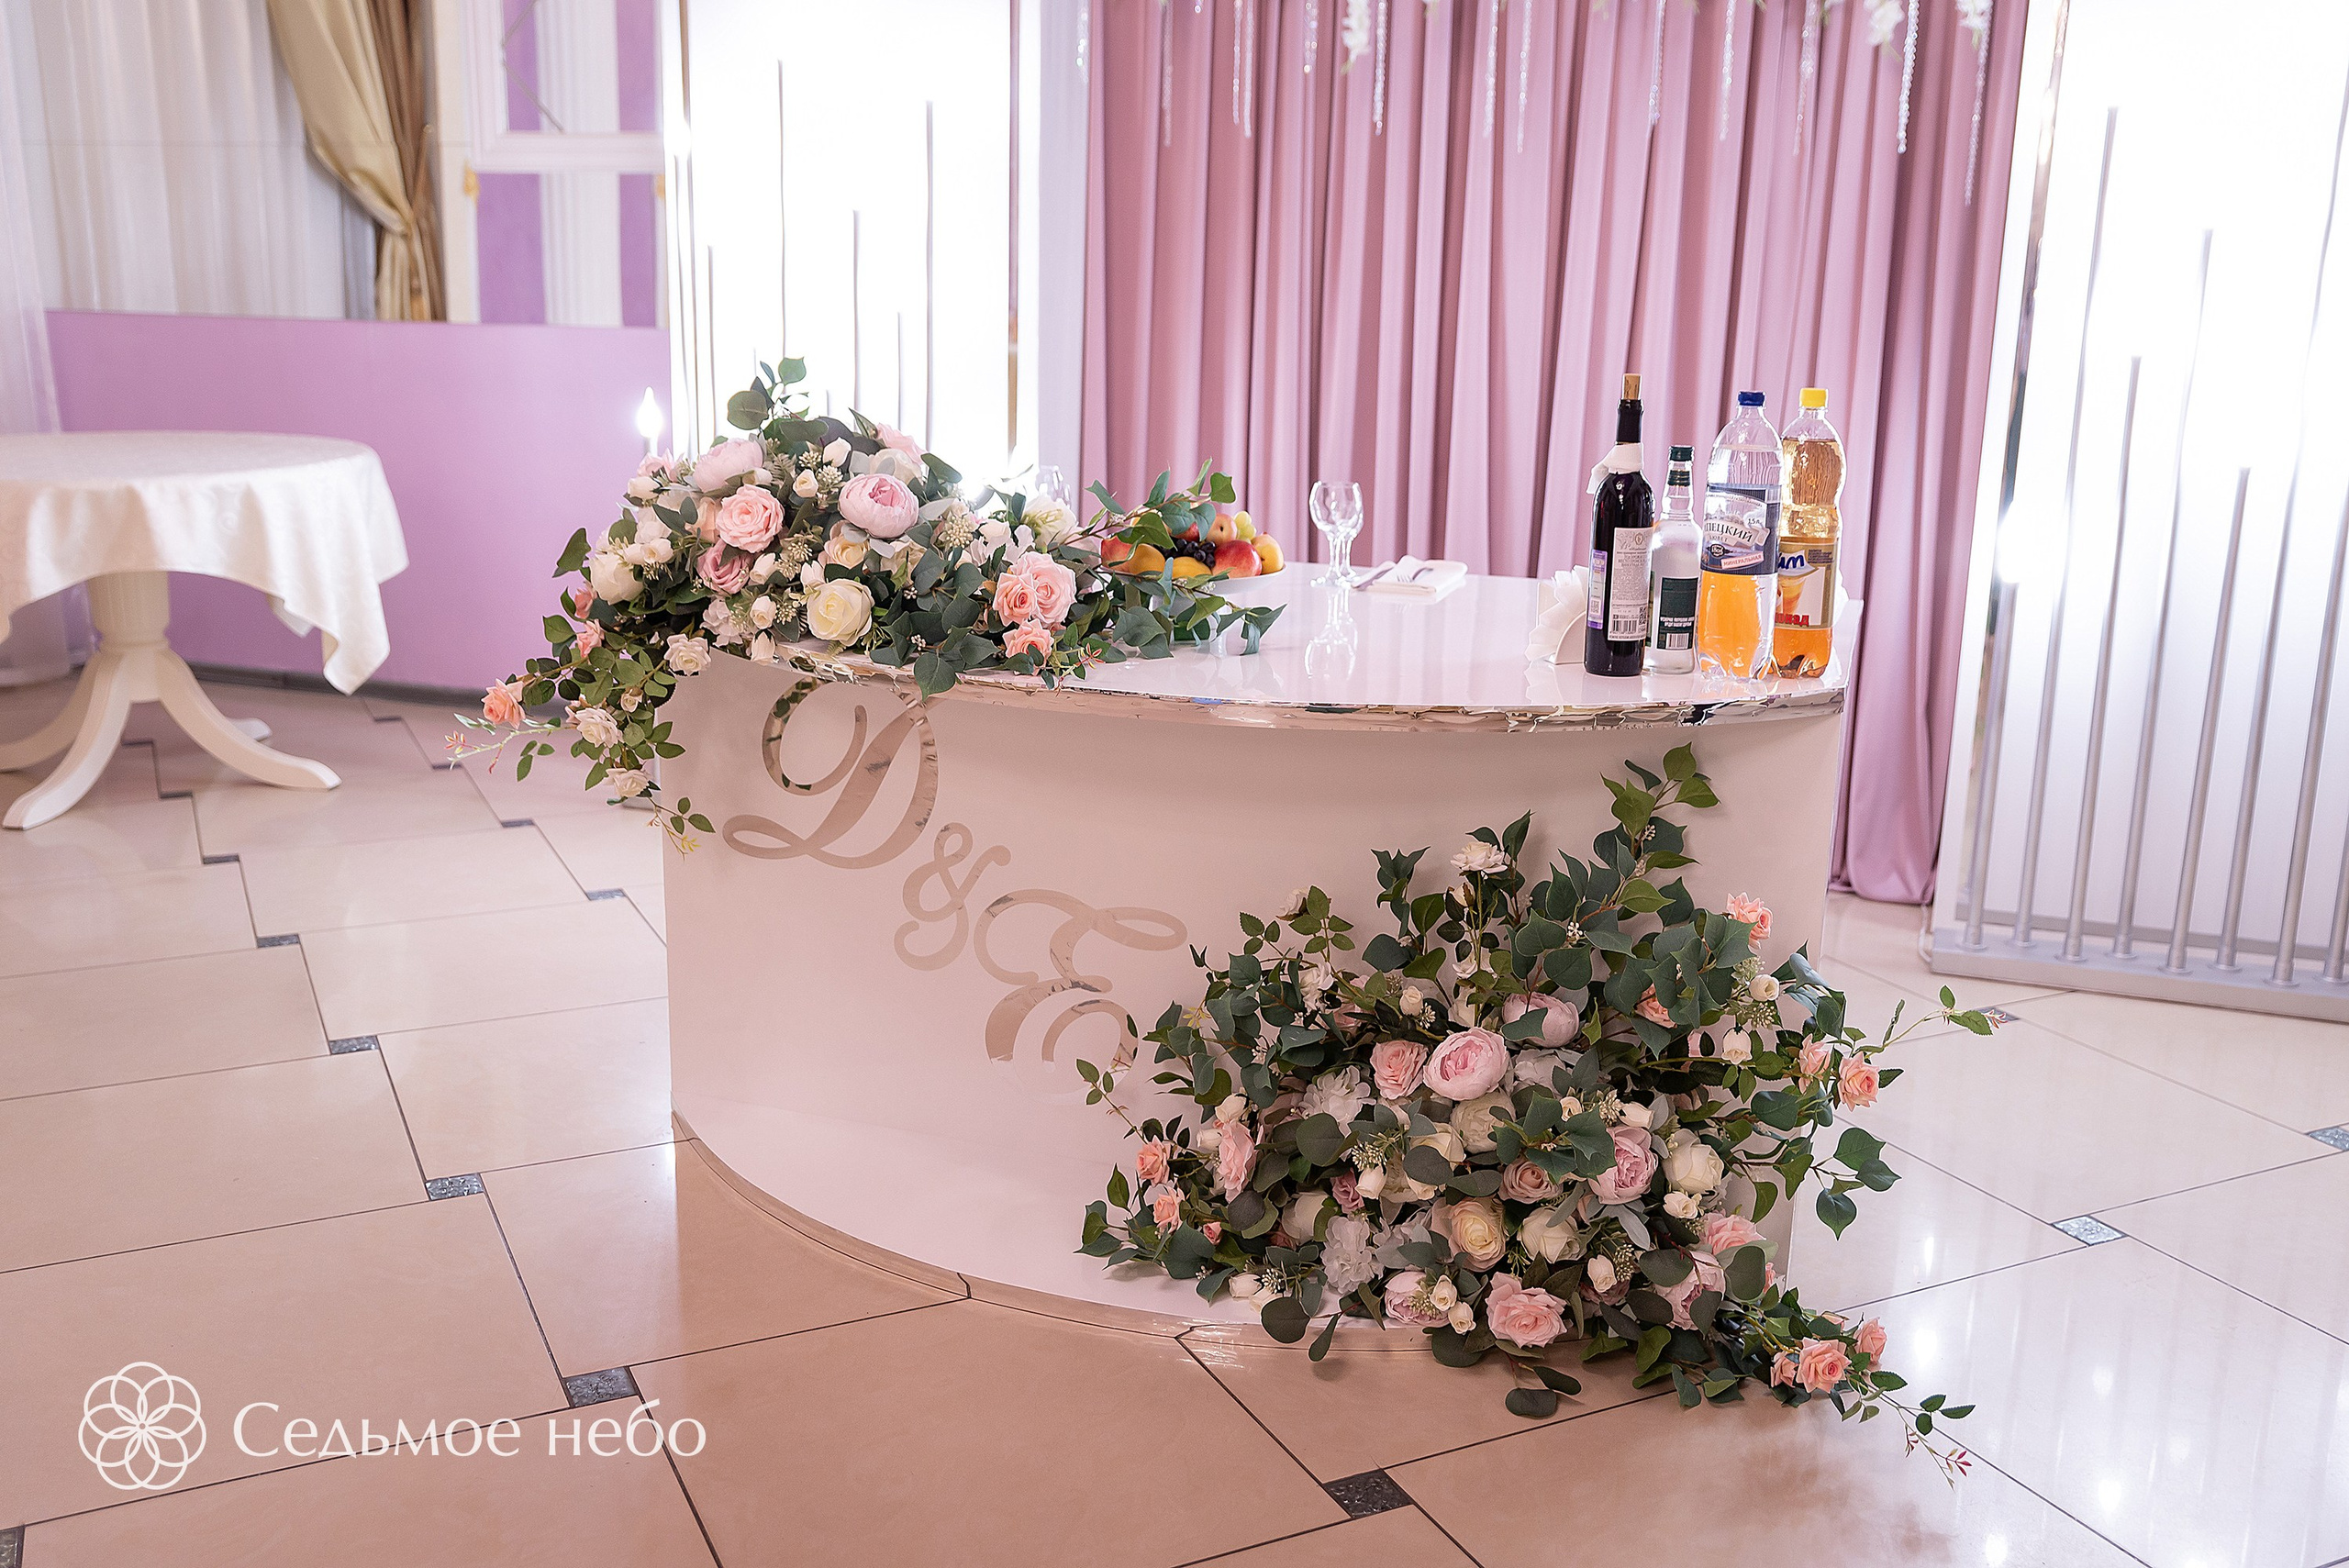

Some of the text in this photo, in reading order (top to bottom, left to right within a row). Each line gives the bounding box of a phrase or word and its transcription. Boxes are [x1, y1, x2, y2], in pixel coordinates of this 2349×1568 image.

[1723, 554, 1762, 566] МИНЕРАЛЬНАЯ
[1775, 612, 1809, 628] онад
[894, 822, 1011, 971] &
[974, 888, 1188, 1092] E
